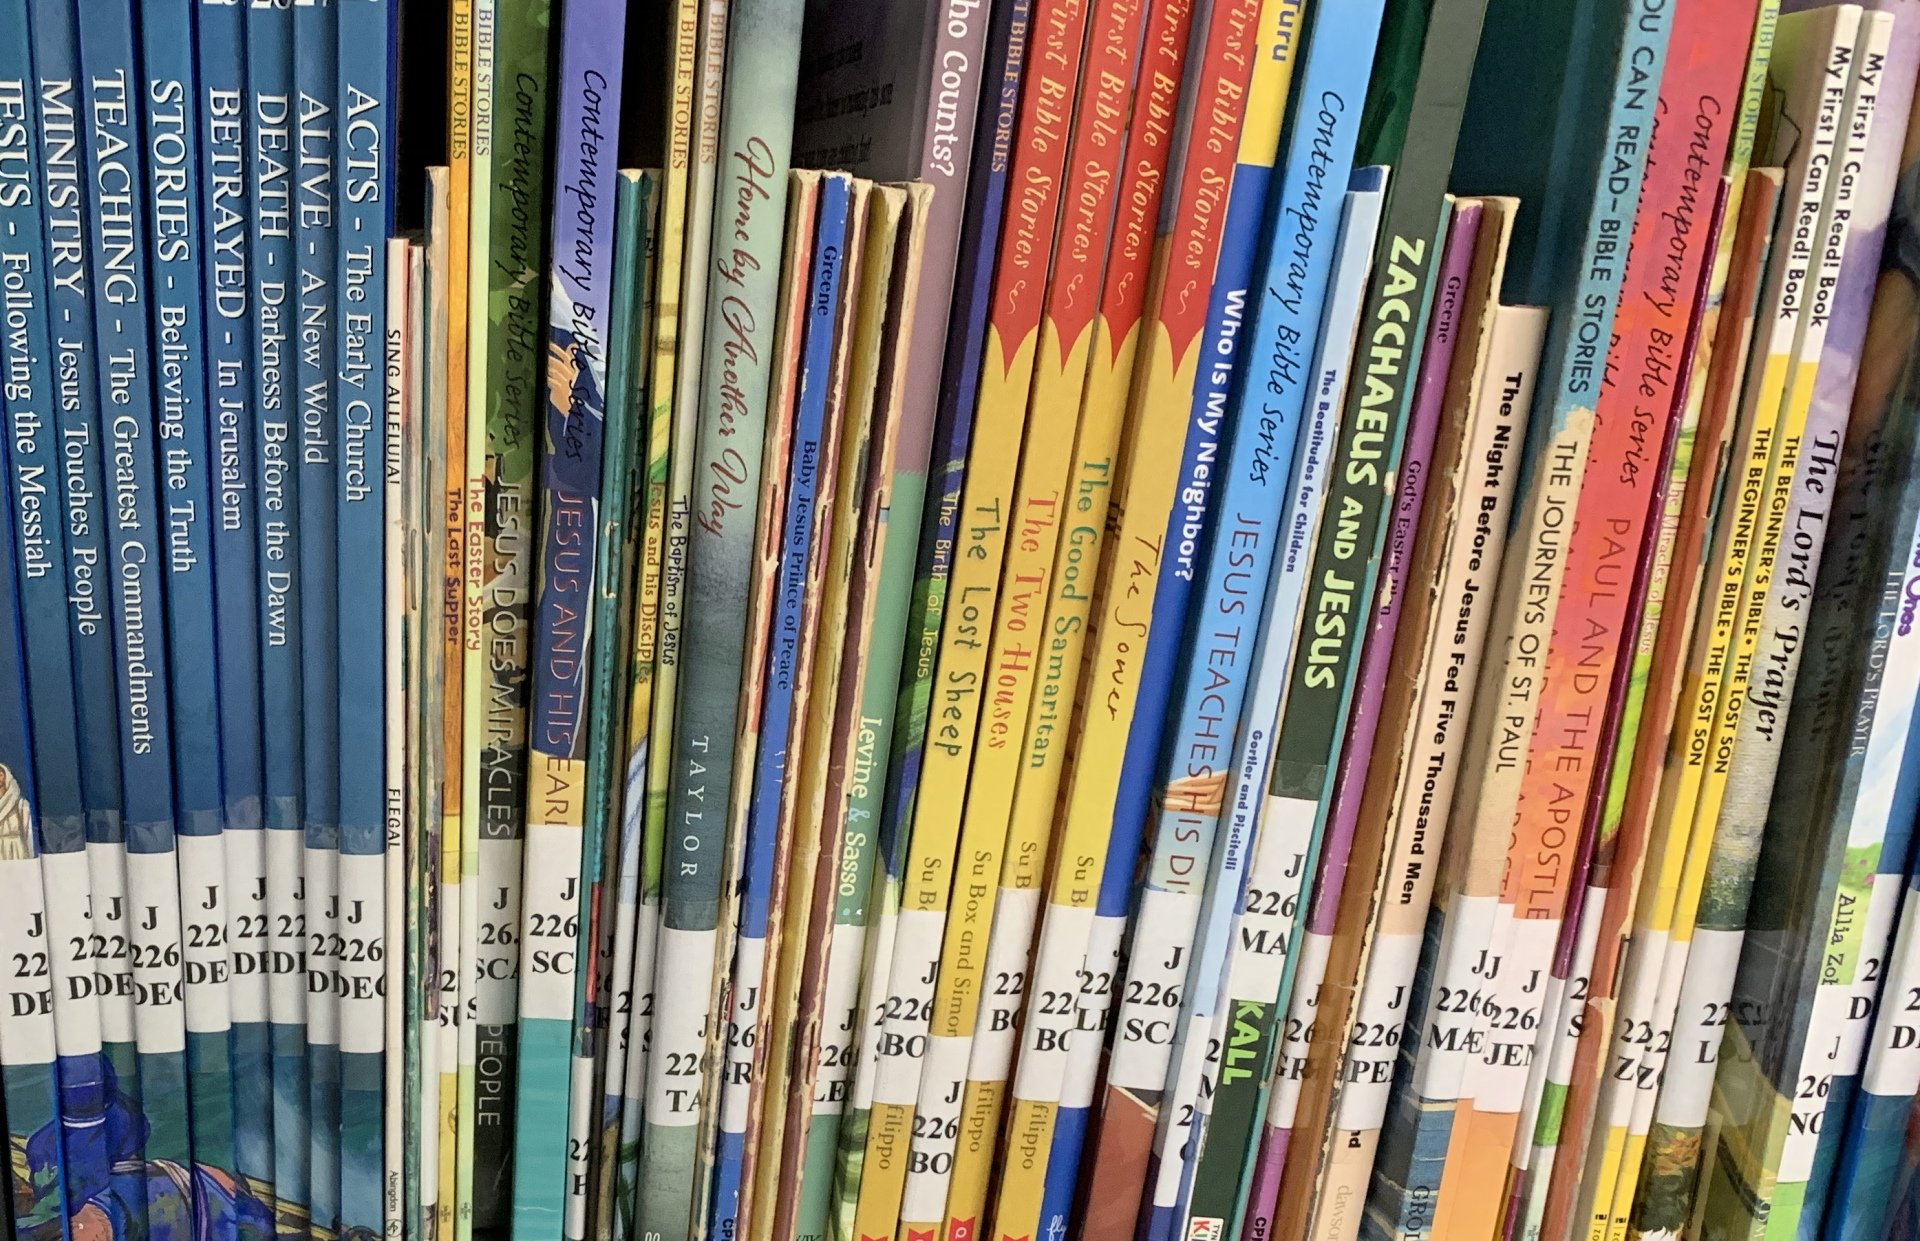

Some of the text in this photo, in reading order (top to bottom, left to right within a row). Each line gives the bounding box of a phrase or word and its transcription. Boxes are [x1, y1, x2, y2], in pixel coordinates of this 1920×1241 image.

[452, 9, 470, 160] BIBLE STORIES
[475, 9, 493, 157] BIBLE STORIES
[673, 21, 697, 169] BIBLE STORIES
[931, 51, 969, 178] Counts?
[1624, 46, 1654, 110] CAN
[559, 69, 607, 292] Contemporary
[1014, 75, 1067, 269] Bible Stories
[1186, 77, 1243, 269] Bible Stories
[1269, 91, 1345, 314] Contemporary
[1644, 95, 1721, 318] Contemporary
[1779, 46, 1851, 320] My First Read! Book
[1810, 53, 1884, 328] My First Read! Book
[150, 79, 198, 573] STORIES Believing Truth
[208, 87, 247, 531] BETRAYED Jerusalem
[299, 90, 332, 464] ALIVE New World
[337, 84, 380, 502] ACTS Early Church
[698, 136, 775, 538] Home by Another Way
[816, 245, 837, 317] Greene
[1436, 276, 1462, 343] Greene
[1569, 294, 1606, 394] STORIES
[2, 252, 52, 579] Following Messiah
[40, 78, 102, 636] MINISTRY Jesus Touches People
[92, 68, 153, 755] TEACHING The Greatest Commandments
[257, 92, 292, 647] DEATH Darkness Before Dawn
[387, 329, 401, 485] SING ALLELUIA!
[1267, 323, 1301, 395] Bible
[1638, 327, 1672, 399] Bible
[1174, 289, 1247, 581] Who My Neighbor?
[1286, 401, 1330, 574] Beatitudes Children
[1304, 235, 1425, 689] ZACCHAEUS AND JESUS
[445, 527, 462, 646] Last Supper
[465, 519, 484, 651] Easter Story
[494, 478, 521, 576] JESUS
[549, 491, 582, 682] JESUS AND
[778, 440, 818, 691] Baby Jesus Prince Peace
[1392, 516, 1412, 576] Easter
[1525, 496, 1563, 625] JOURNEYS
[1588, 518, 1631, 609] PAUL
[1651, 513, 1679, 587] Miracles
[1747, 430, 1840, 743] The Lord's Prayer
[490, 588, 517, 673] DOES
[634, 602, 656, 685] Disciples
[662, 537, 687, 667] Baptism Jesus
[917, 539, 953, 678] Birth Jesus
[936, 498, 1000, 758] The Lost Sheep
[988, 491, 1059, 749] The Two Houses
[1031, 458, 1111, 769] The Good Samaritan
[1108, 535, 1162, 720] The Sower
[1399, 425, 1512, 905] Night Before Jesus Fed Five Thousand Men
[1573, 618, 1608, 695] AND
[1689, 467, 1762, 766] BEGINNER'S BIBLE LOST SON
[1714, 476, 1790, 773] BEGINNER'S BIBLE LOST SON
[1174, 513, 1262, 844] JESUS TEACHES HIS
[1496, 715, 1524, 774] PAUL
[1507, 676, 1531, 707] ST.
[1552, 708, 1592, 772] THE
[387, 789, 401, 850] FLEGAL
[680, 735, 710, 876] TAYLOR
[839, 715, 882, 897] Levine Sasso
[1225, 730, 1263, 870] Gortler Piscitelli
[1284, 854, 1302, 878] J
[348, 901, 362, 924] J
[530, 914, 578, 938] 226
[560, 877, 578, 901] J
[966, 882, 987, 924] Box
[1242, 928, 1287, 955] MA
[1247, 890, 1295, 916] 226
[1831, 895, 1856, 945] Allia
[1352, 1022, 1400, 1047] 226
[1388, 985, 1404, 1009] J
[913, 1116, 957, 1139] 226
[946, 1082, 961, 1103] J
